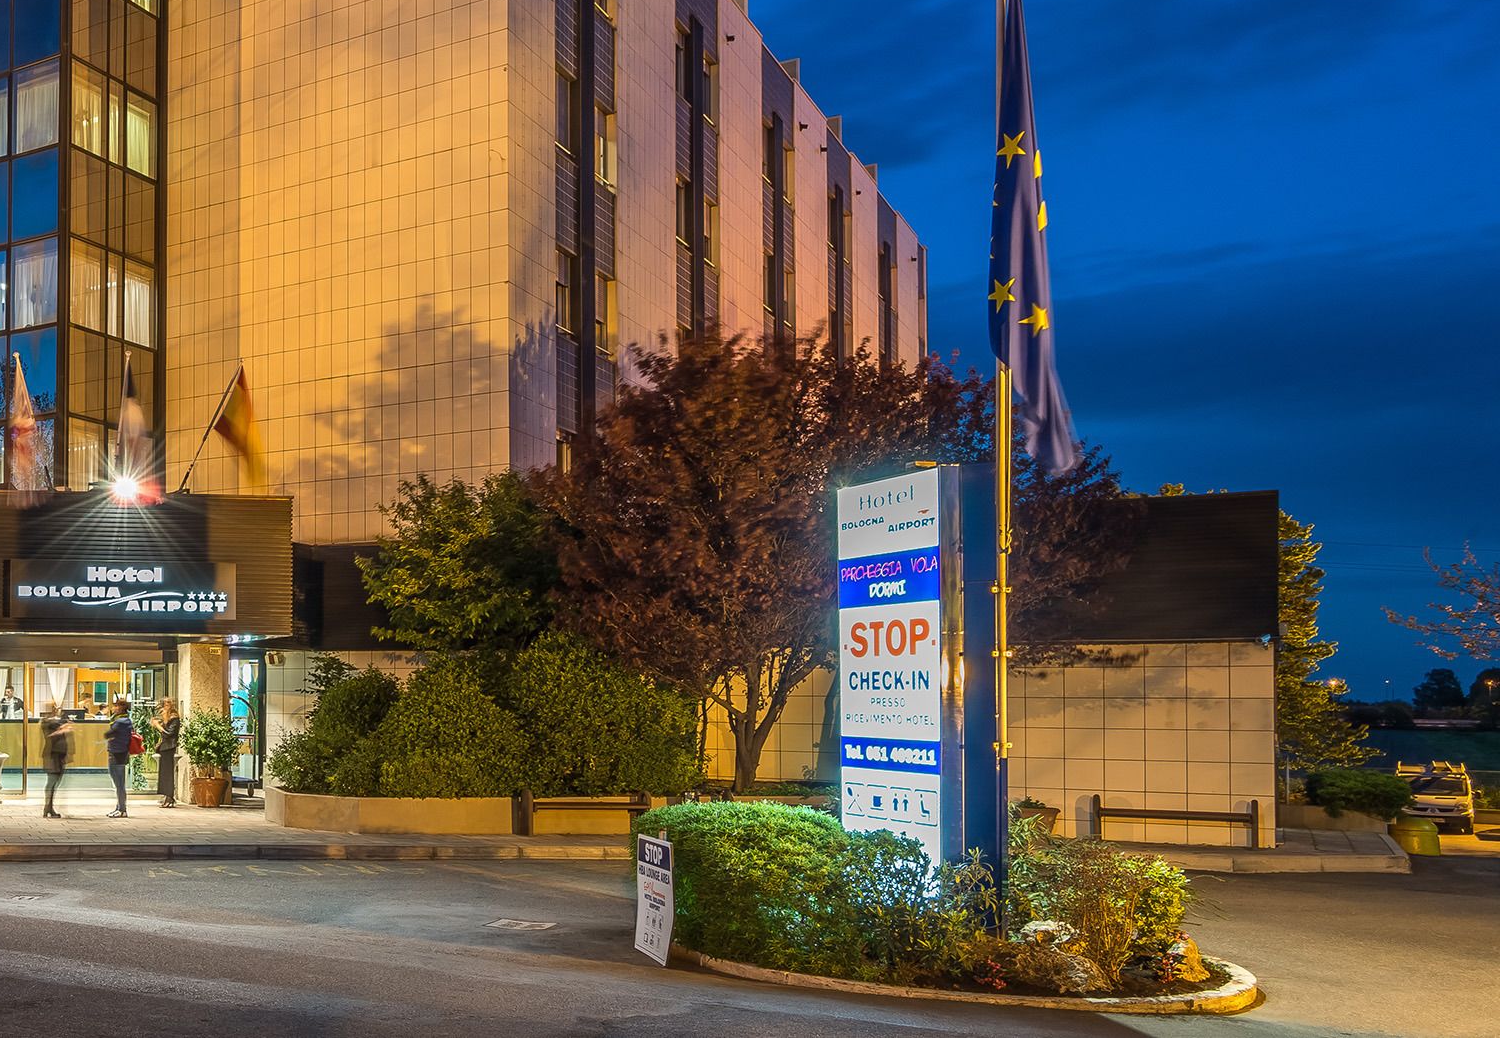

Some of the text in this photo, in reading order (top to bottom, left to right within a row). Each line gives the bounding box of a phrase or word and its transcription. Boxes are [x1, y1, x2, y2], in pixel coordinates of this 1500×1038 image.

[860, 485, 913, 510] Hotel
[842, 517, 935, 532] BOLOGNA AIRPORT
[87, 567, 162, 582] Hotel
[841, 556, 937, 582] PARCHEGGIA VOLA
[869, 580, 906, 598] DORMI
[18, 586, 228, 612] BOLOGNA AIRPORT
[851, 618, 930, 658] STOP
[849, 671, 929, 690] CHECK-IN
[871, 697, 905, 707] PRESSO
[846, 714, 934, 725] RICEVIMENTO HOTEL
[645, 843, 662, 865] STOP
